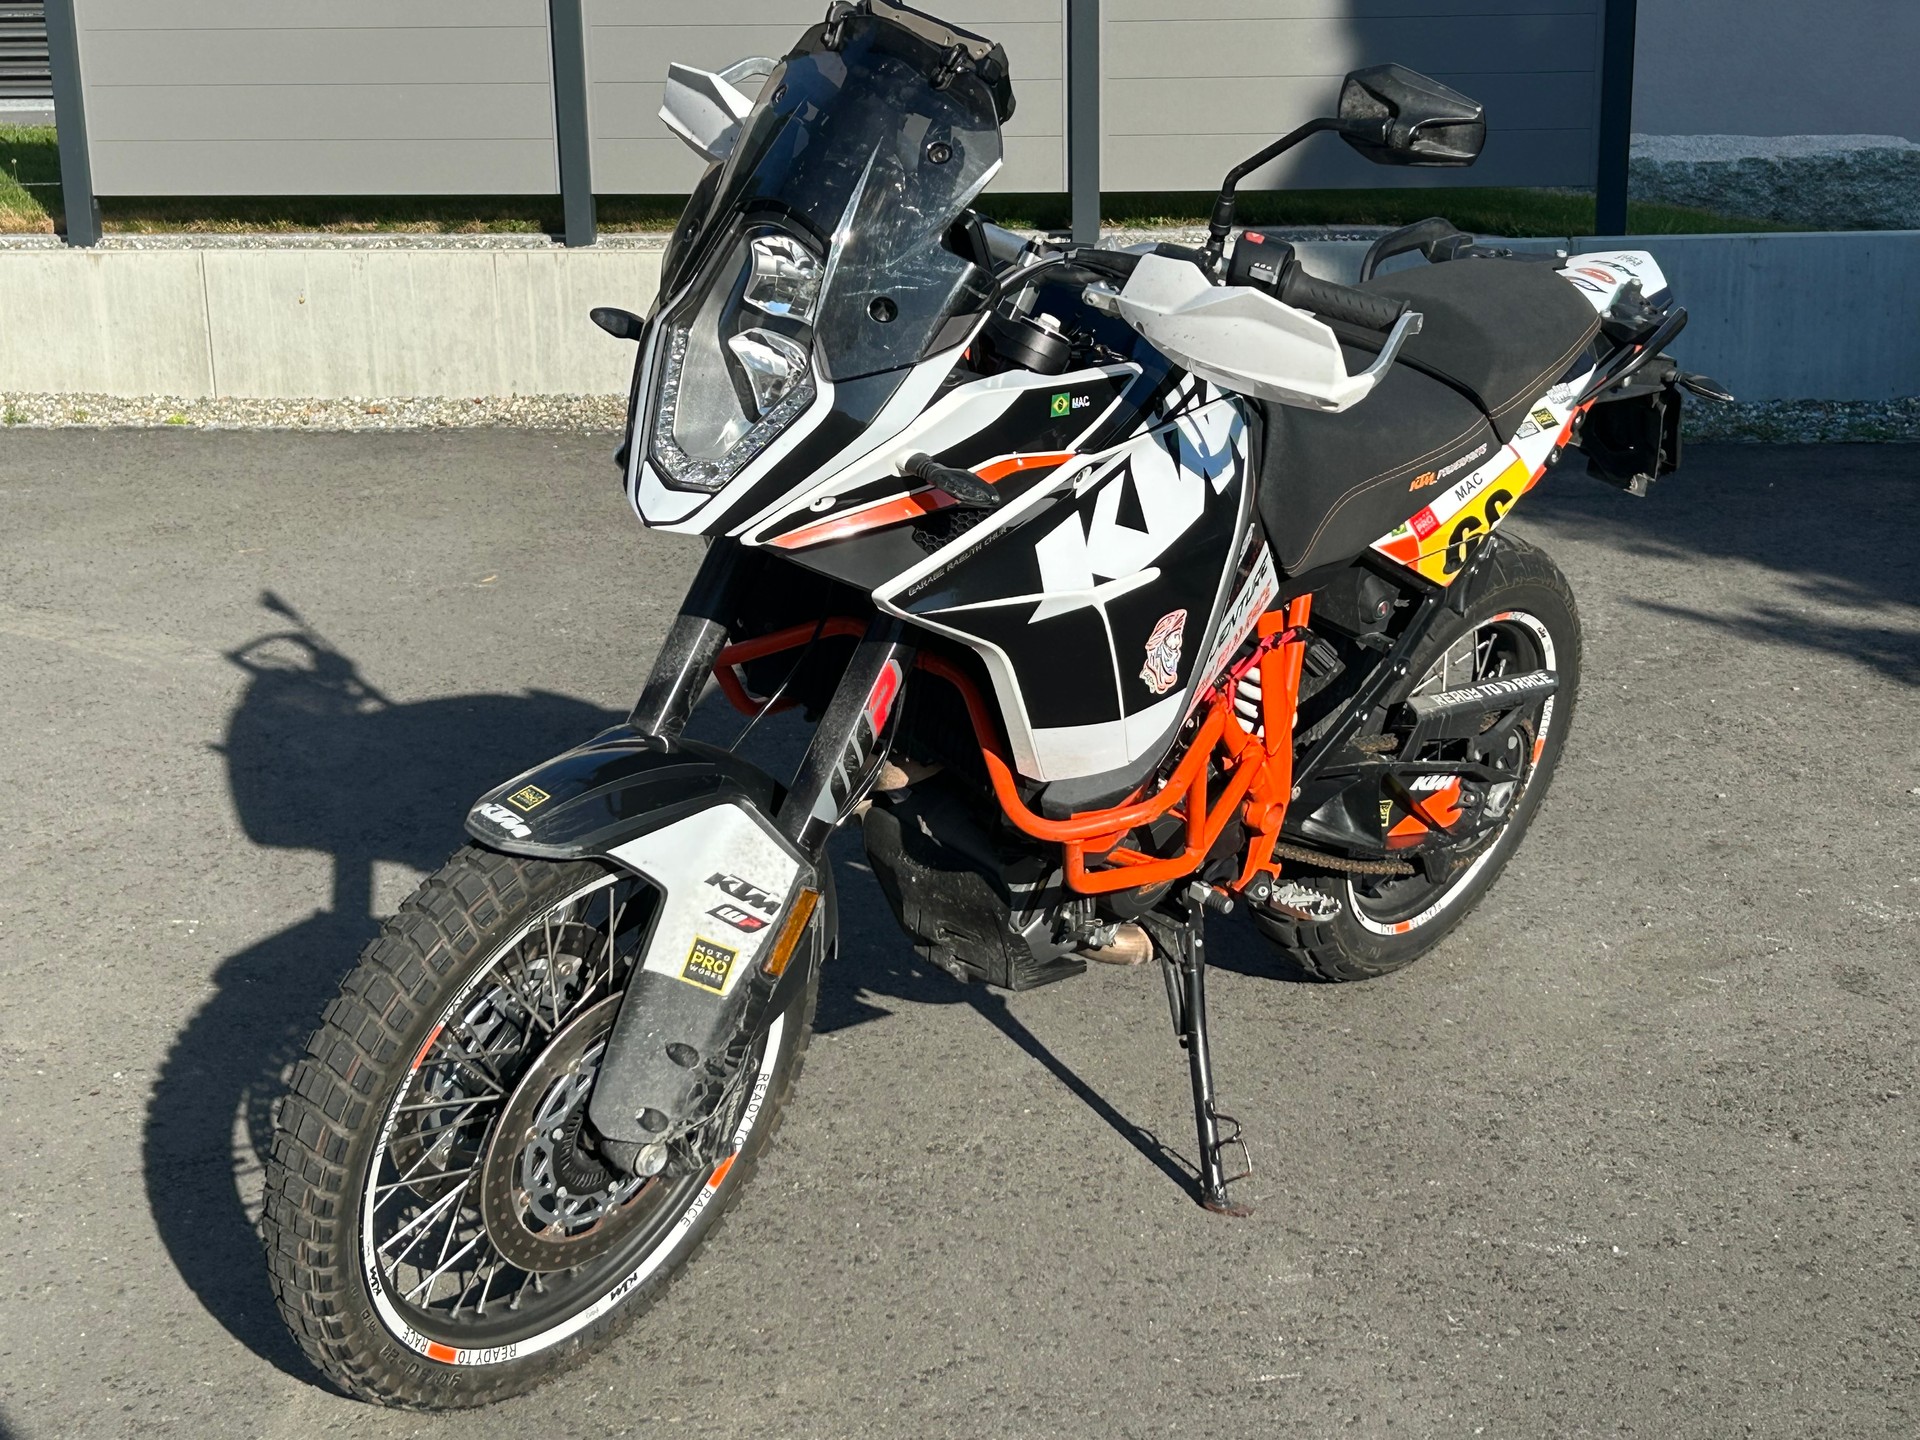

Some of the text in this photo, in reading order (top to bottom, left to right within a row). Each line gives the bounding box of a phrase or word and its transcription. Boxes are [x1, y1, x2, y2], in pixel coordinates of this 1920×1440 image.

[1028, 374, 1246, 624] KTM
[1454, 472, 1483, 502] MAC
[1430, 672, 1555, 706] READY TO RACE
[1409, 775, 1457, 791] KTM
[704, 872, 782, 916] KTM
[691, 951, 728, 974] PRO
[696, 944, 731, 962] MOTO
[689, 963, 723, 981] WORKS
[680, 1073, 770, 1229] READY TO RACE
[402, 1326, 517, 1365] READY TO RACE
